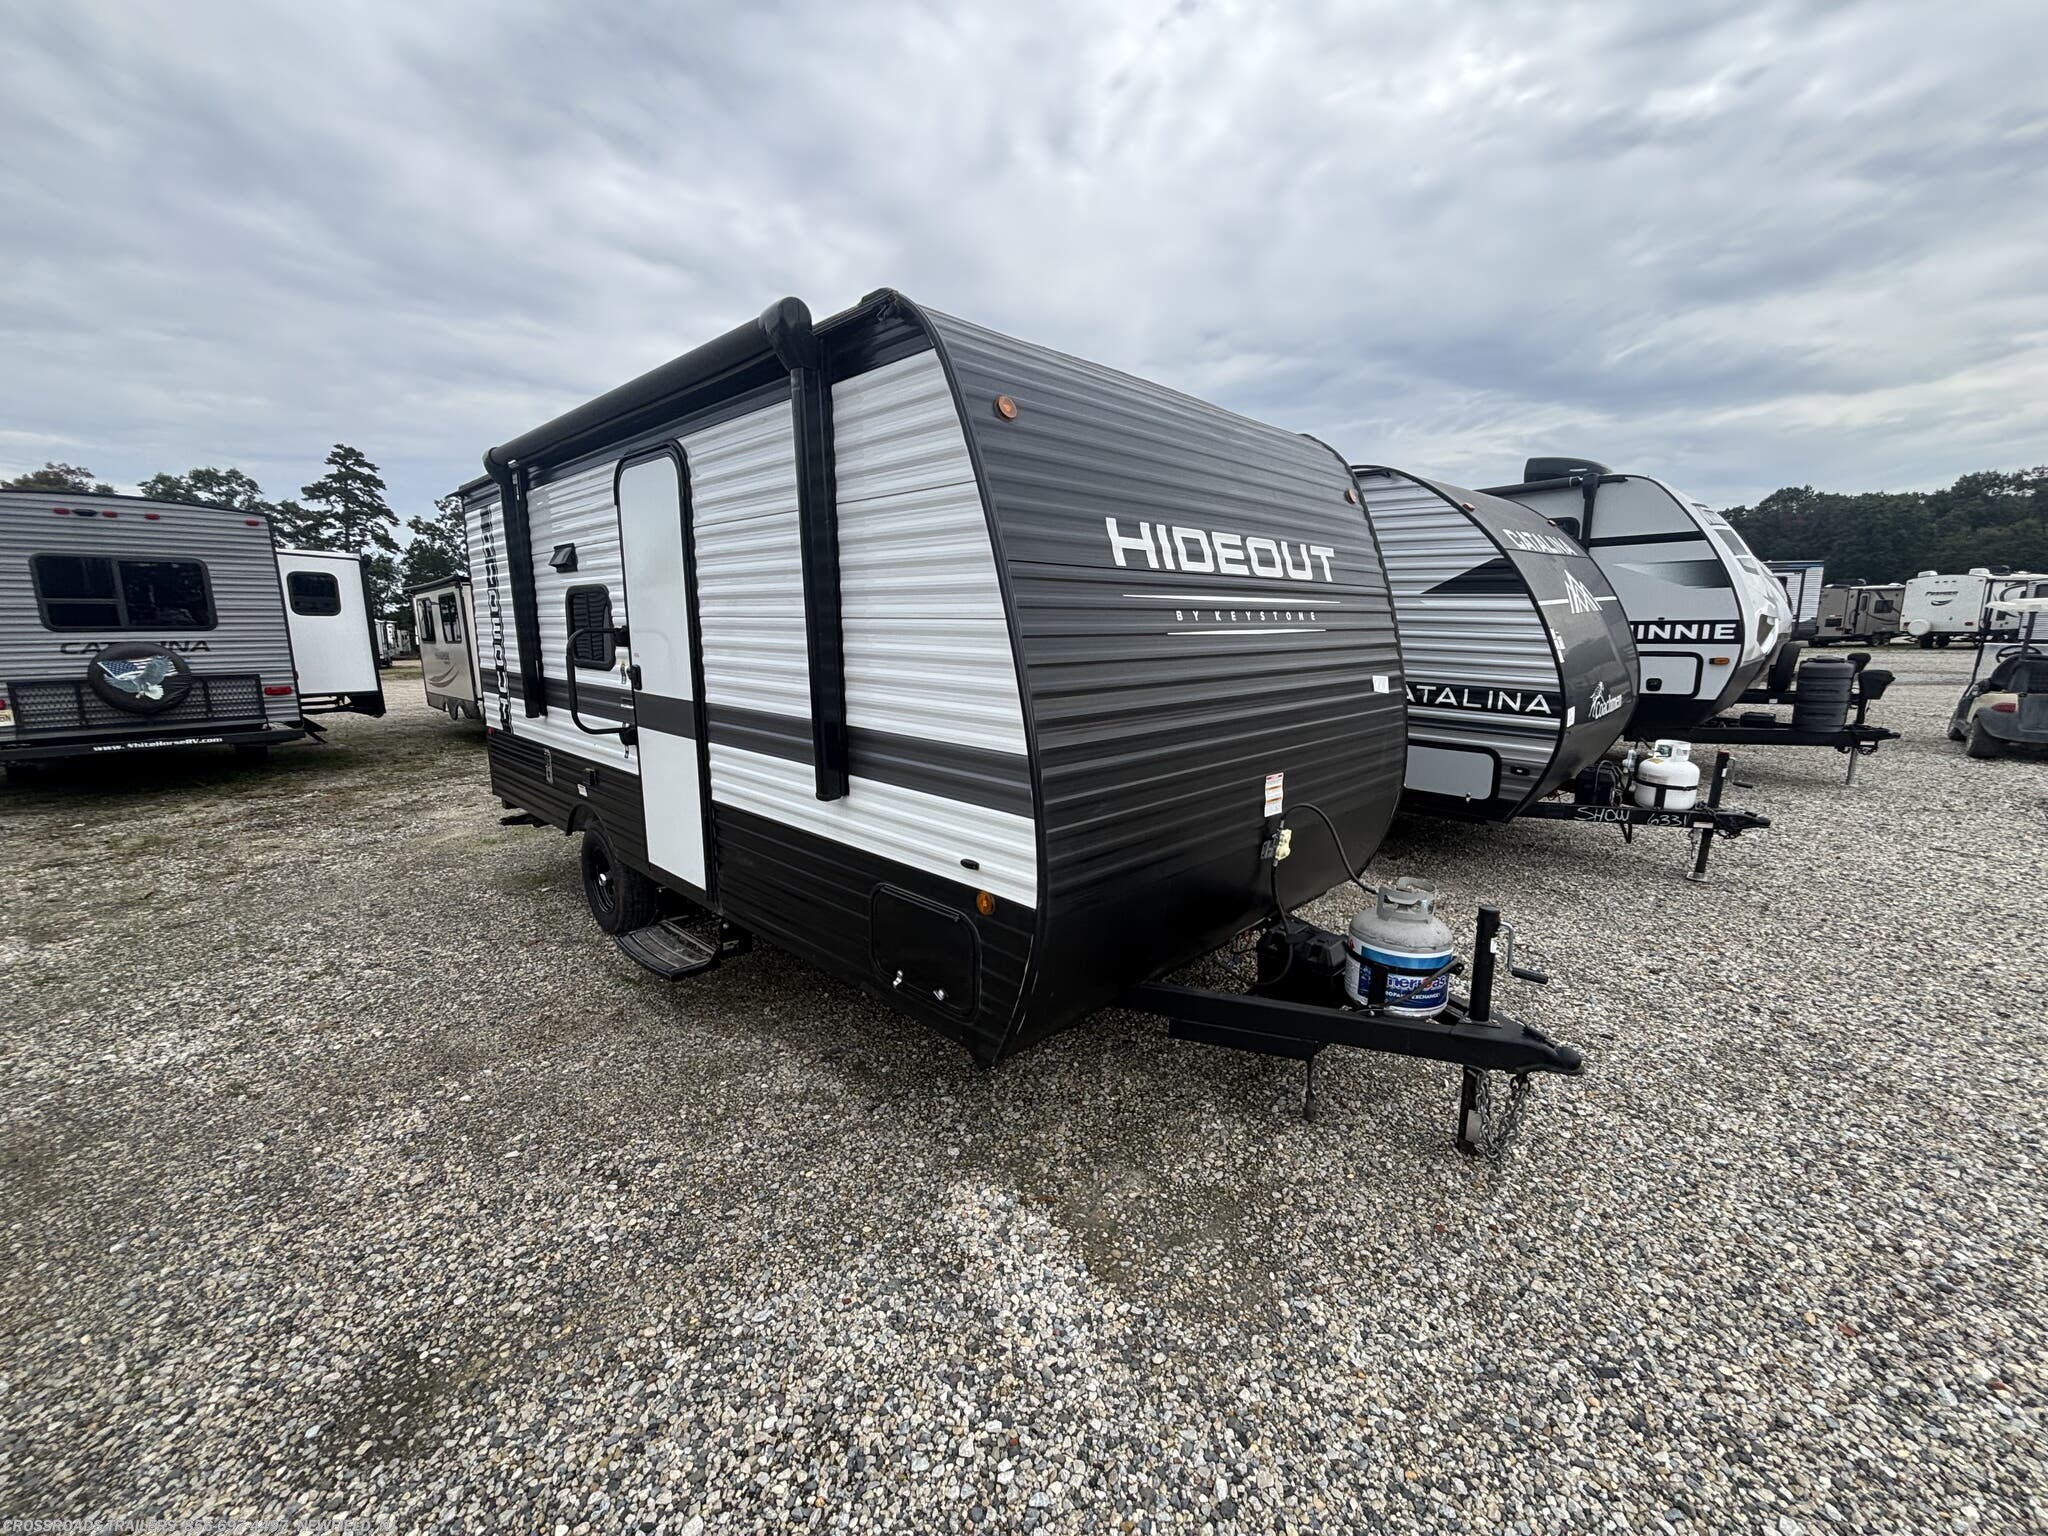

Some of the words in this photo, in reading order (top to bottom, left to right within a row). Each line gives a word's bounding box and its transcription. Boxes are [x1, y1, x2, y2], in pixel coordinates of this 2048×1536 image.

[1105, 516, 1335, 582] HIDEOUT
[1502, 528, 1578, 556] CATALINA
[1175, 610, 1200, 622] BY
[1214, 610, 1317, 622] KEYSTONE
[1629, 623, 1737, 640] INNIE
[1405, 684, 1552, 714] ATALINA
[1573, 806, 1631, 822] SHOW
[1646, 812, 1688, 828] 6331
